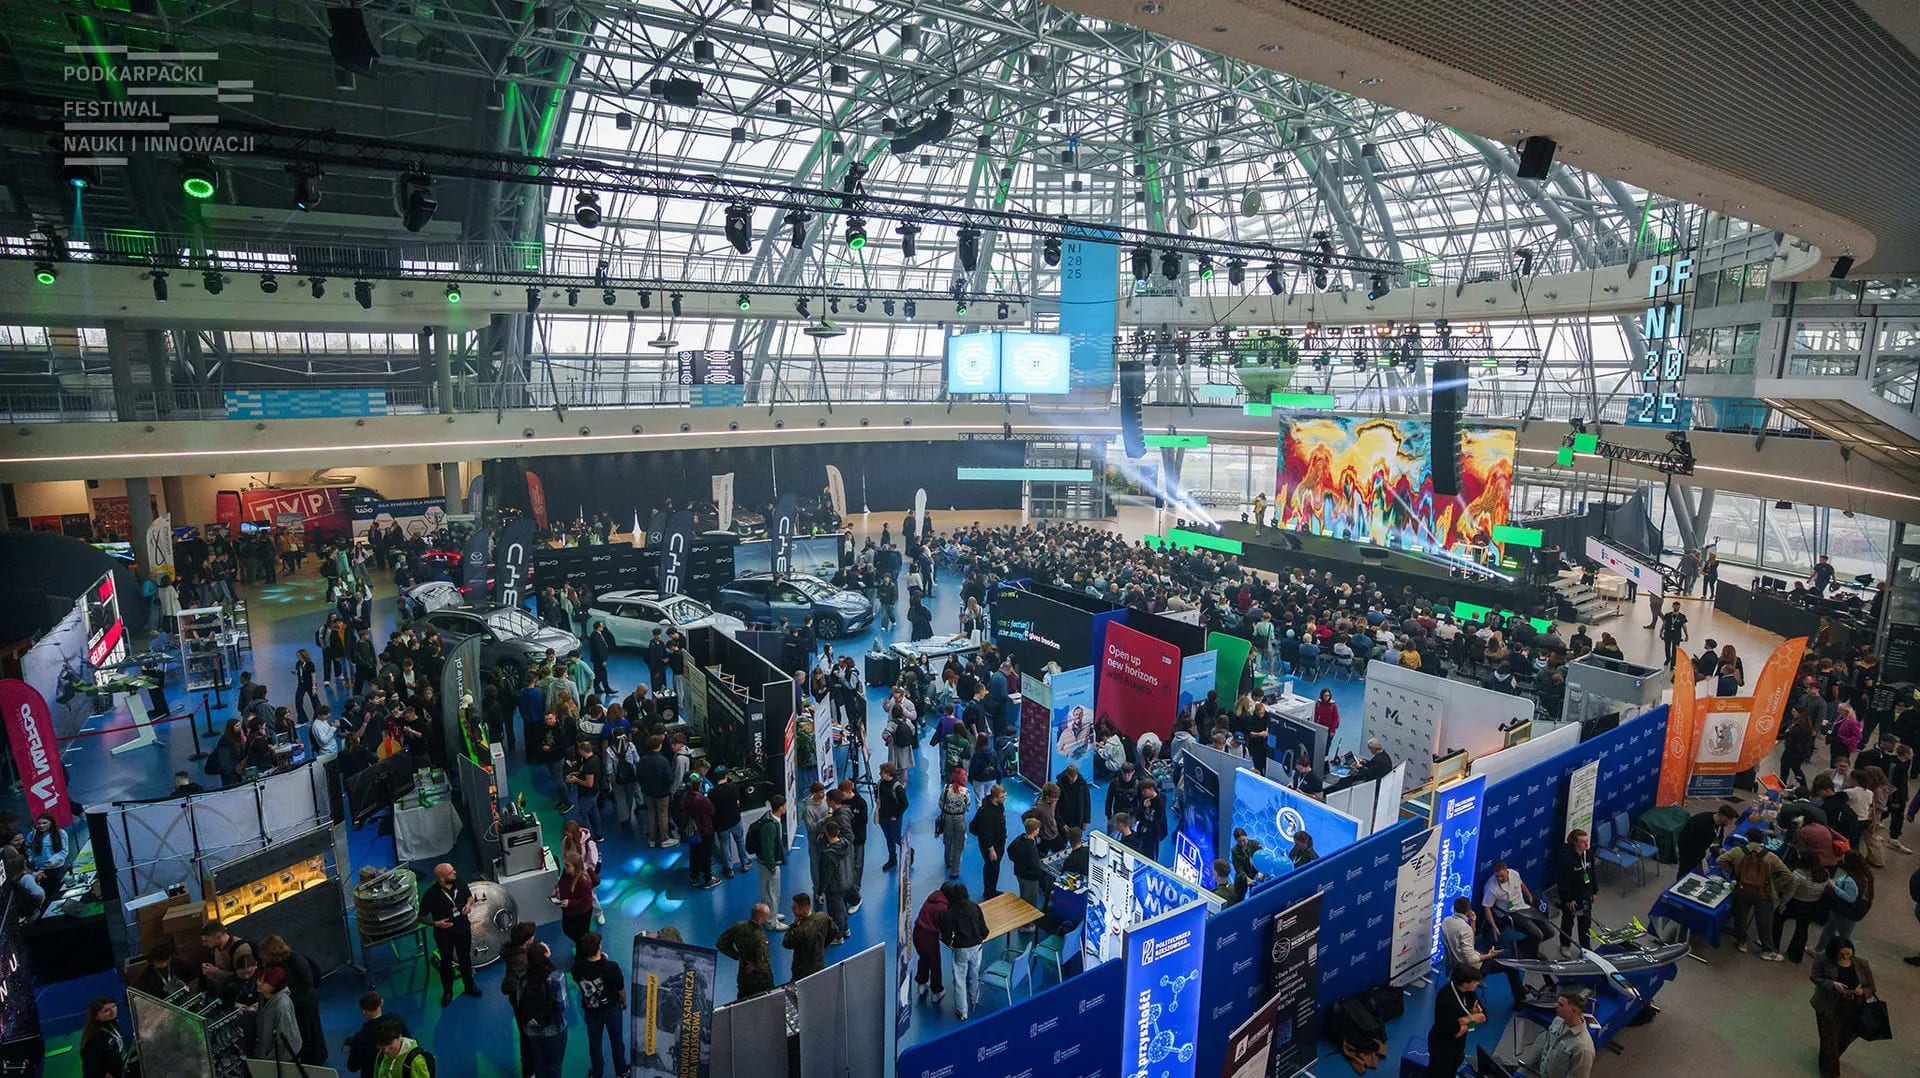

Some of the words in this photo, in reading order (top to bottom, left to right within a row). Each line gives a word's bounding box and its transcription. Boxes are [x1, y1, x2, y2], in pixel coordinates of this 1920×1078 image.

[1067, 256, 1082, 266] 20
[1068, 243, 1082, 253] NI
[1067, 268, 1082, 279] 25
[1648, 258, 1693, 298] PF
[1645, 304, 1684, 339] NI
[1643, 349, 1682, 381] 20
[1638, 392, 1678, 423] 25
[255, 493, 324, 523] TVP
[777, 516, 790, 574] BYD
[503, 543, 524, 609] BYD
[666, 532, 684, 594] BYD
[1108, 644, 1130, 661] Open
[1130, 656, 1142, 666] up
[1108, 658, 1124, 671] new
[1125, 664, 1158, 686] horizons
[1439, 838, 1450, 899] przyszłości
[1538, 900, 1548, 912] 29
[682, 969, 695, 1031] ZASADNICZA
[689, 1011, 701, 1063] WOJSKOWA
[1138, 990, 1152, 1066] przyszłości
